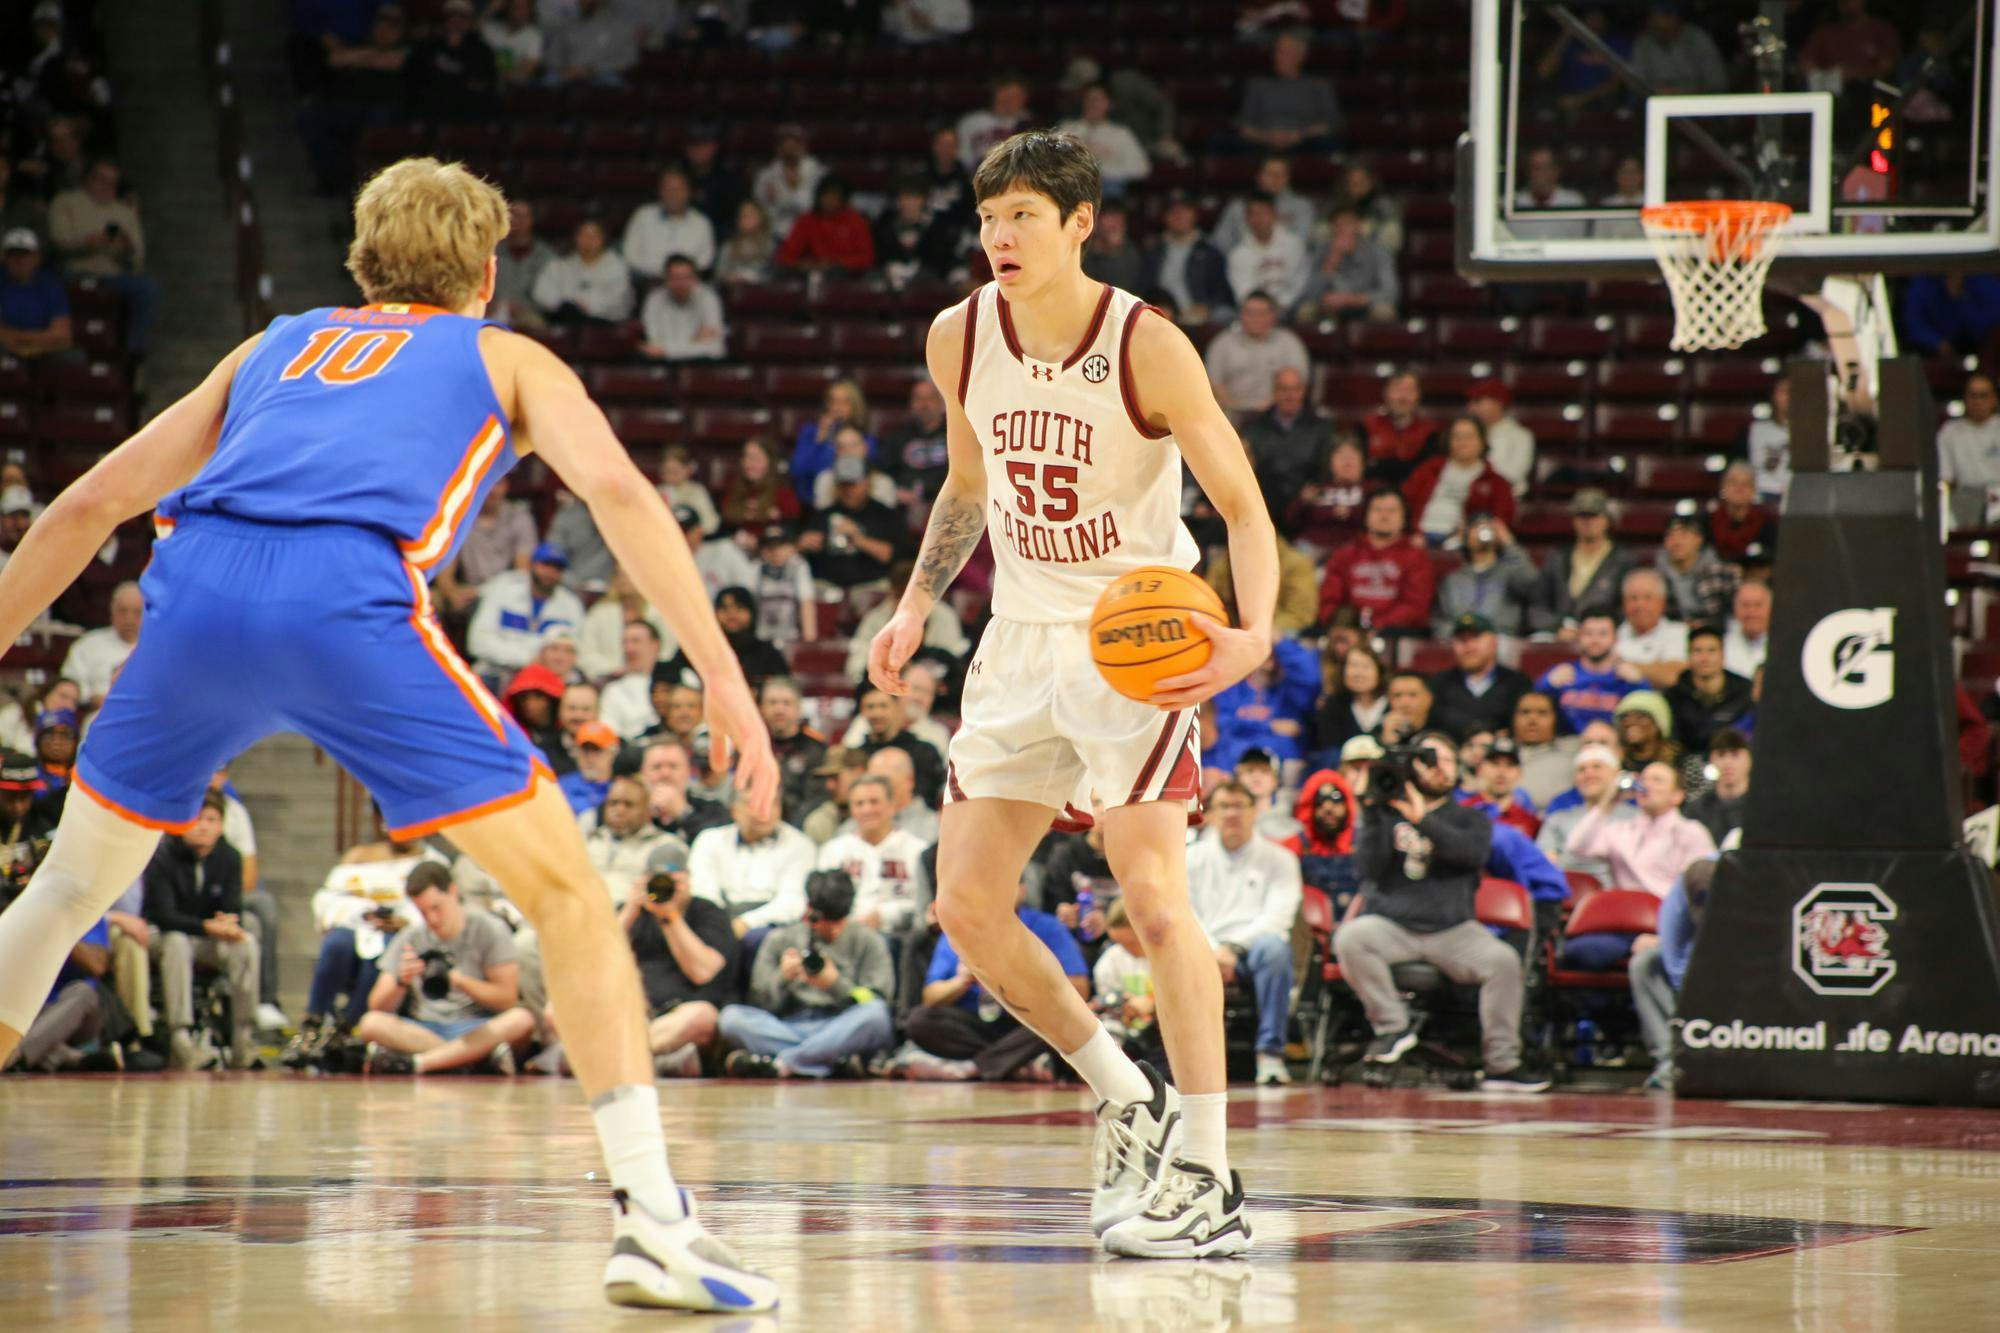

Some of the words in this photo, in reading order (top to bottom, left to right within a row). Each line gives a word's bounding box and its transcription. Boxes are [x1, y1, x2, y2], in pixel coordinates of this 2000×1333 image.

[279, 326, 414, 384] 10
[1083, 355, 1109, 382] SEC
[992, 410, 1094, 466] SOUTH
[1005, 460, 1079, 522] 55
[1801, 607, 1898, 709] G
[1681, 1018, 1827, 1050] Colonial
[1898, 1024, 2000, 1057] Arena
